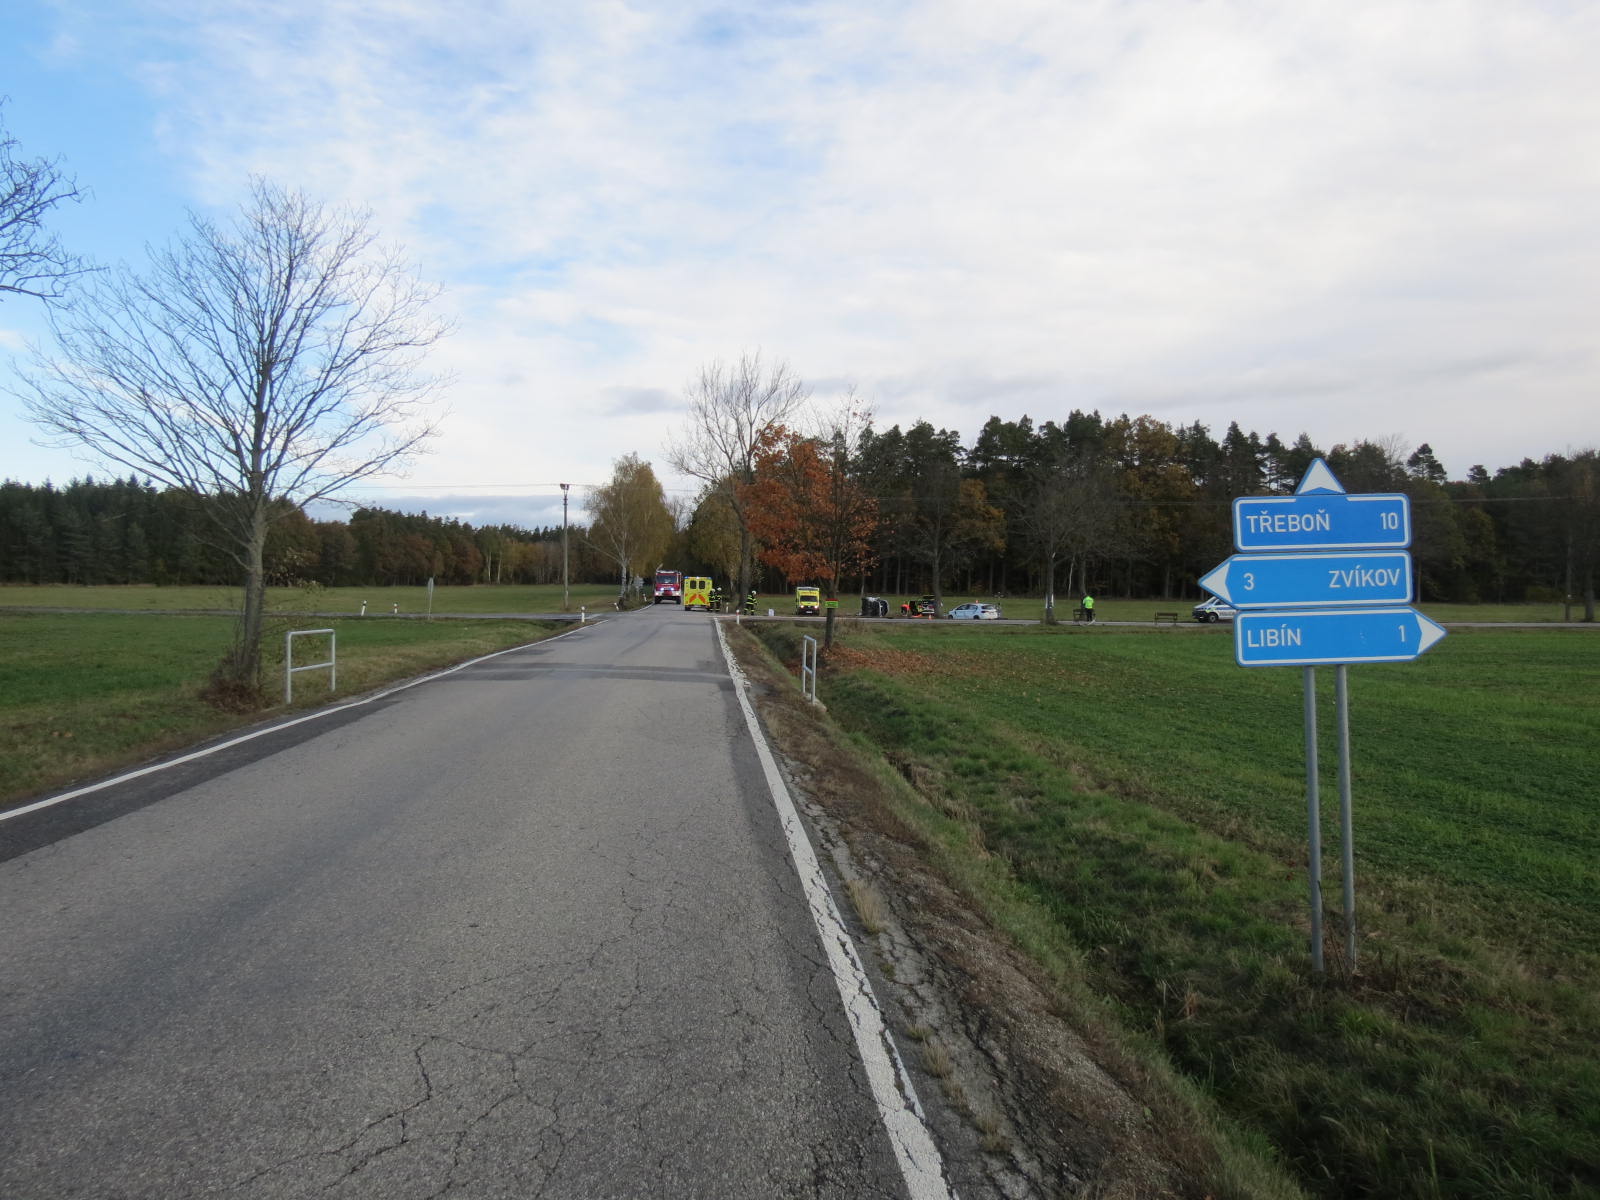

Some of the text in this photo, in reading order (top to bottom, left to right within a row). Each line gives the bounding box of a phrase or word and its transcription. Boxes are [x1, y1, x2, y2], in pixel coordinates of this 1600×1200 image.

[1246, 509, 1399, 533] TŘEBOŇ 10
[1243, 565, 1401, 591] 3 ZVÍKOV
[1247, 624, 1406, 648] LIBÍN 1
